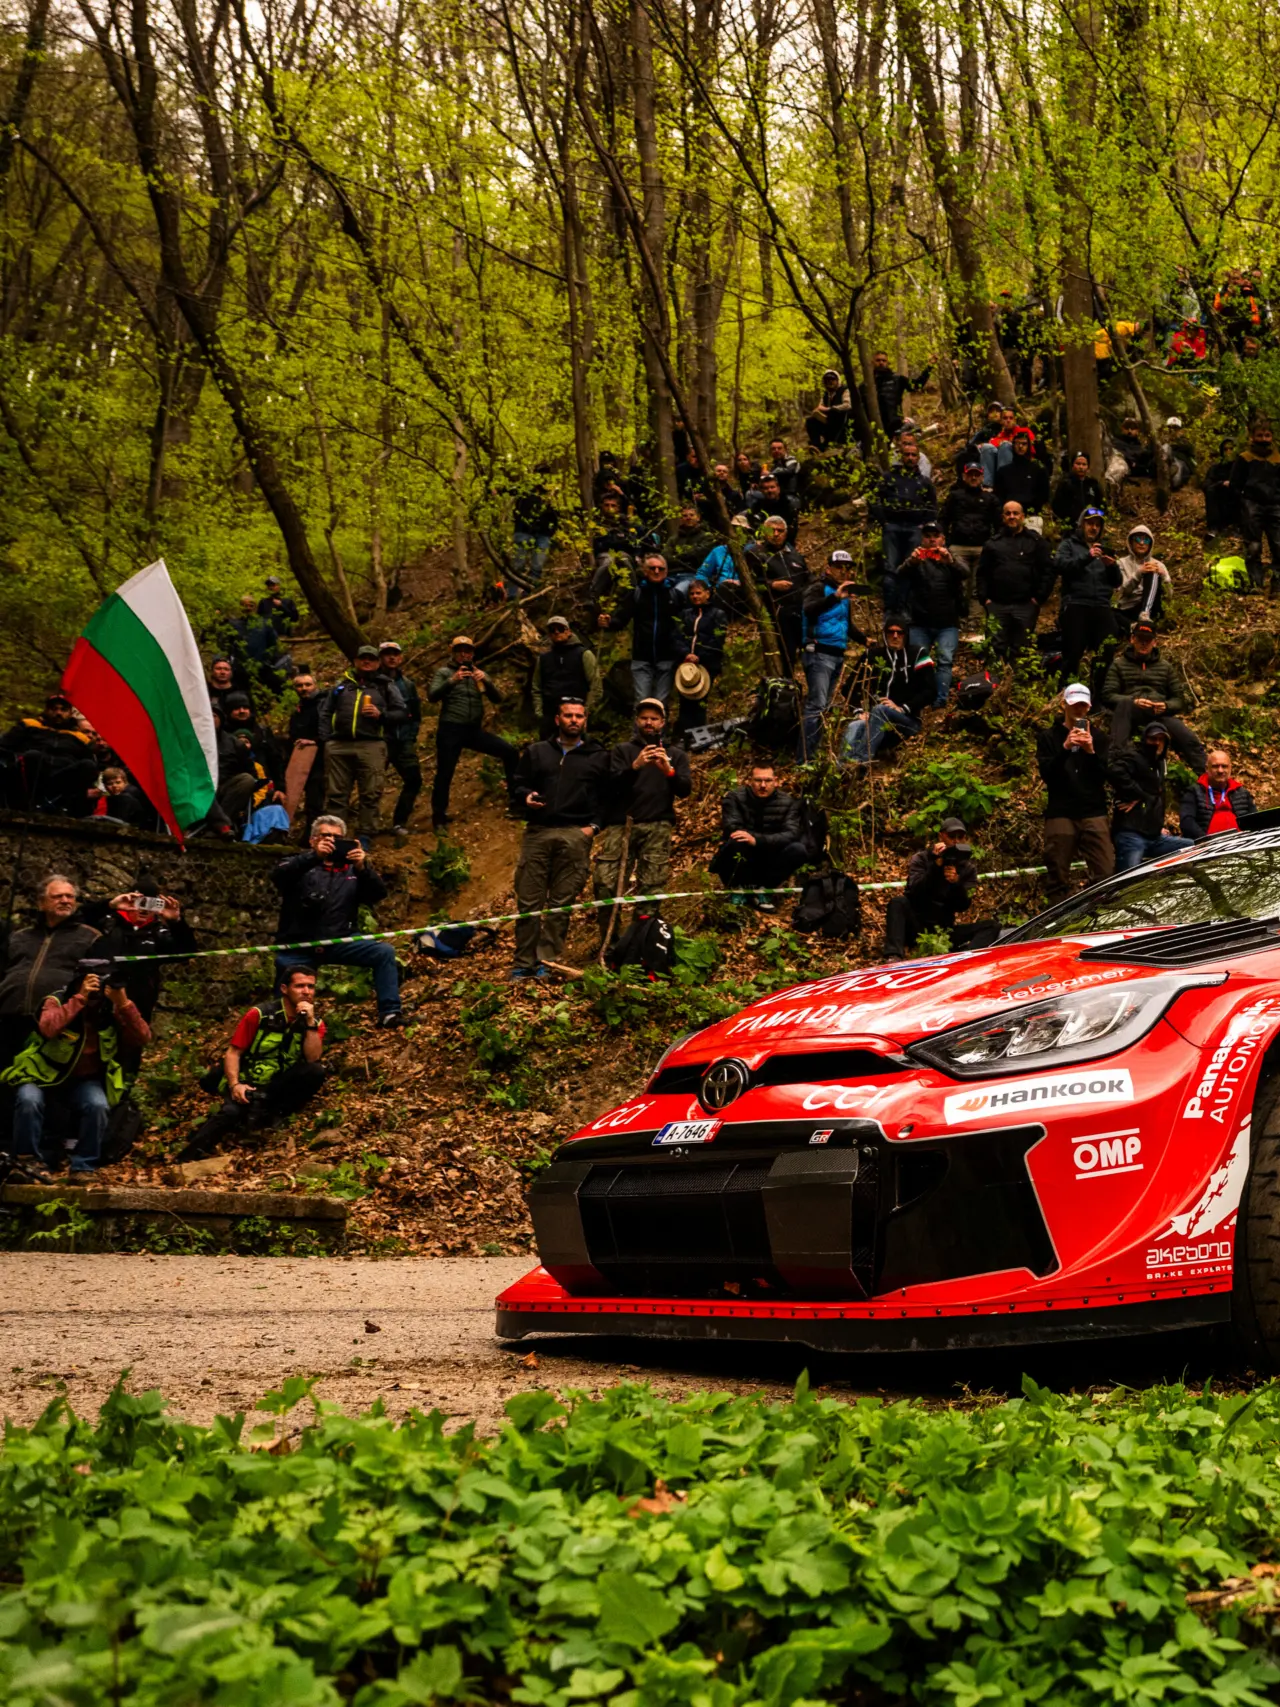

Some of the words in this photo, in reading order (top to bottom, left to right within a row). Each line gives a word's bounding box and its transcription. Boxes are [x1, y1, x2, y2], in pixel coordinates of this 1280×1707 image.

[753, 967, 950, 1008] DENSO
[967, 967, 1130, 1013] codebeamer
[1183, 998, 1275, 1118] Panasic
[592, 1101, 656, 1130] CCi
[666, 1123, 710, 1140] A-7646
[1073, 1136, 1142, 1171] OMP
[1146, 1242, 1231, 1264] akebono
[1190, 1265, 1232, 1275] EXPERTS
